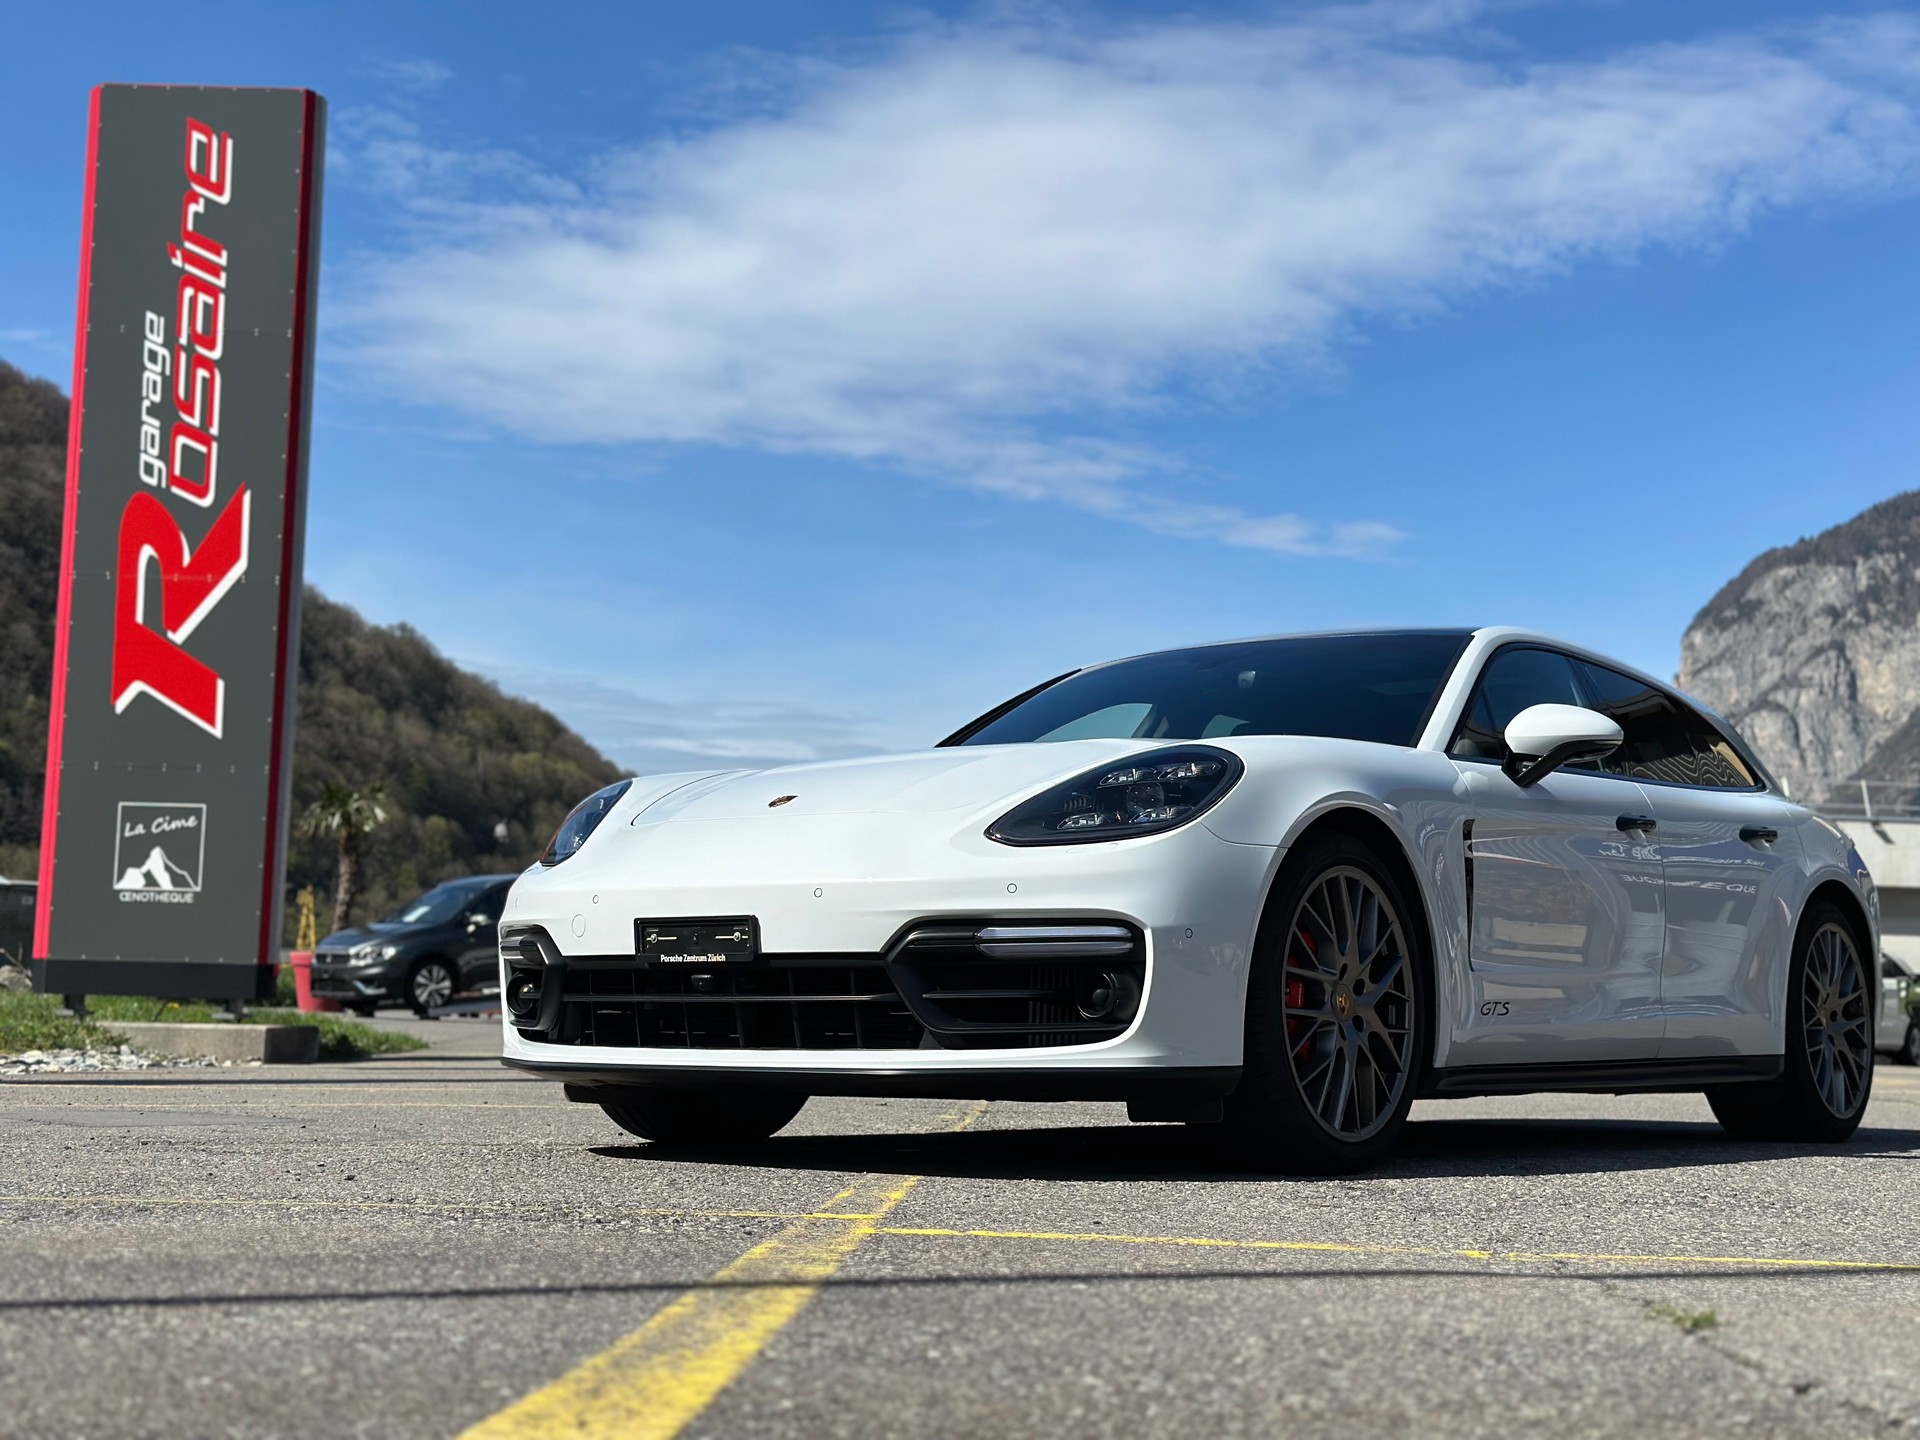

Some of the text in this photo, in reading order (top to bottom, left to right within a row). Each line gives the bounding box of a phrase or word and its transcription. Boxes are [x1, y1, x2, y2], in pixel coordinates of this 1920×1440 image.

[138, 311, 171, 489] garage
[111, 117, 251, 740] Rosaire
[124, 815, 198, 838] La Cime
[661, 953, 726, 963] Porsche Zentrum Zürich
[1480, 1001, 1511, 1016] GTS
